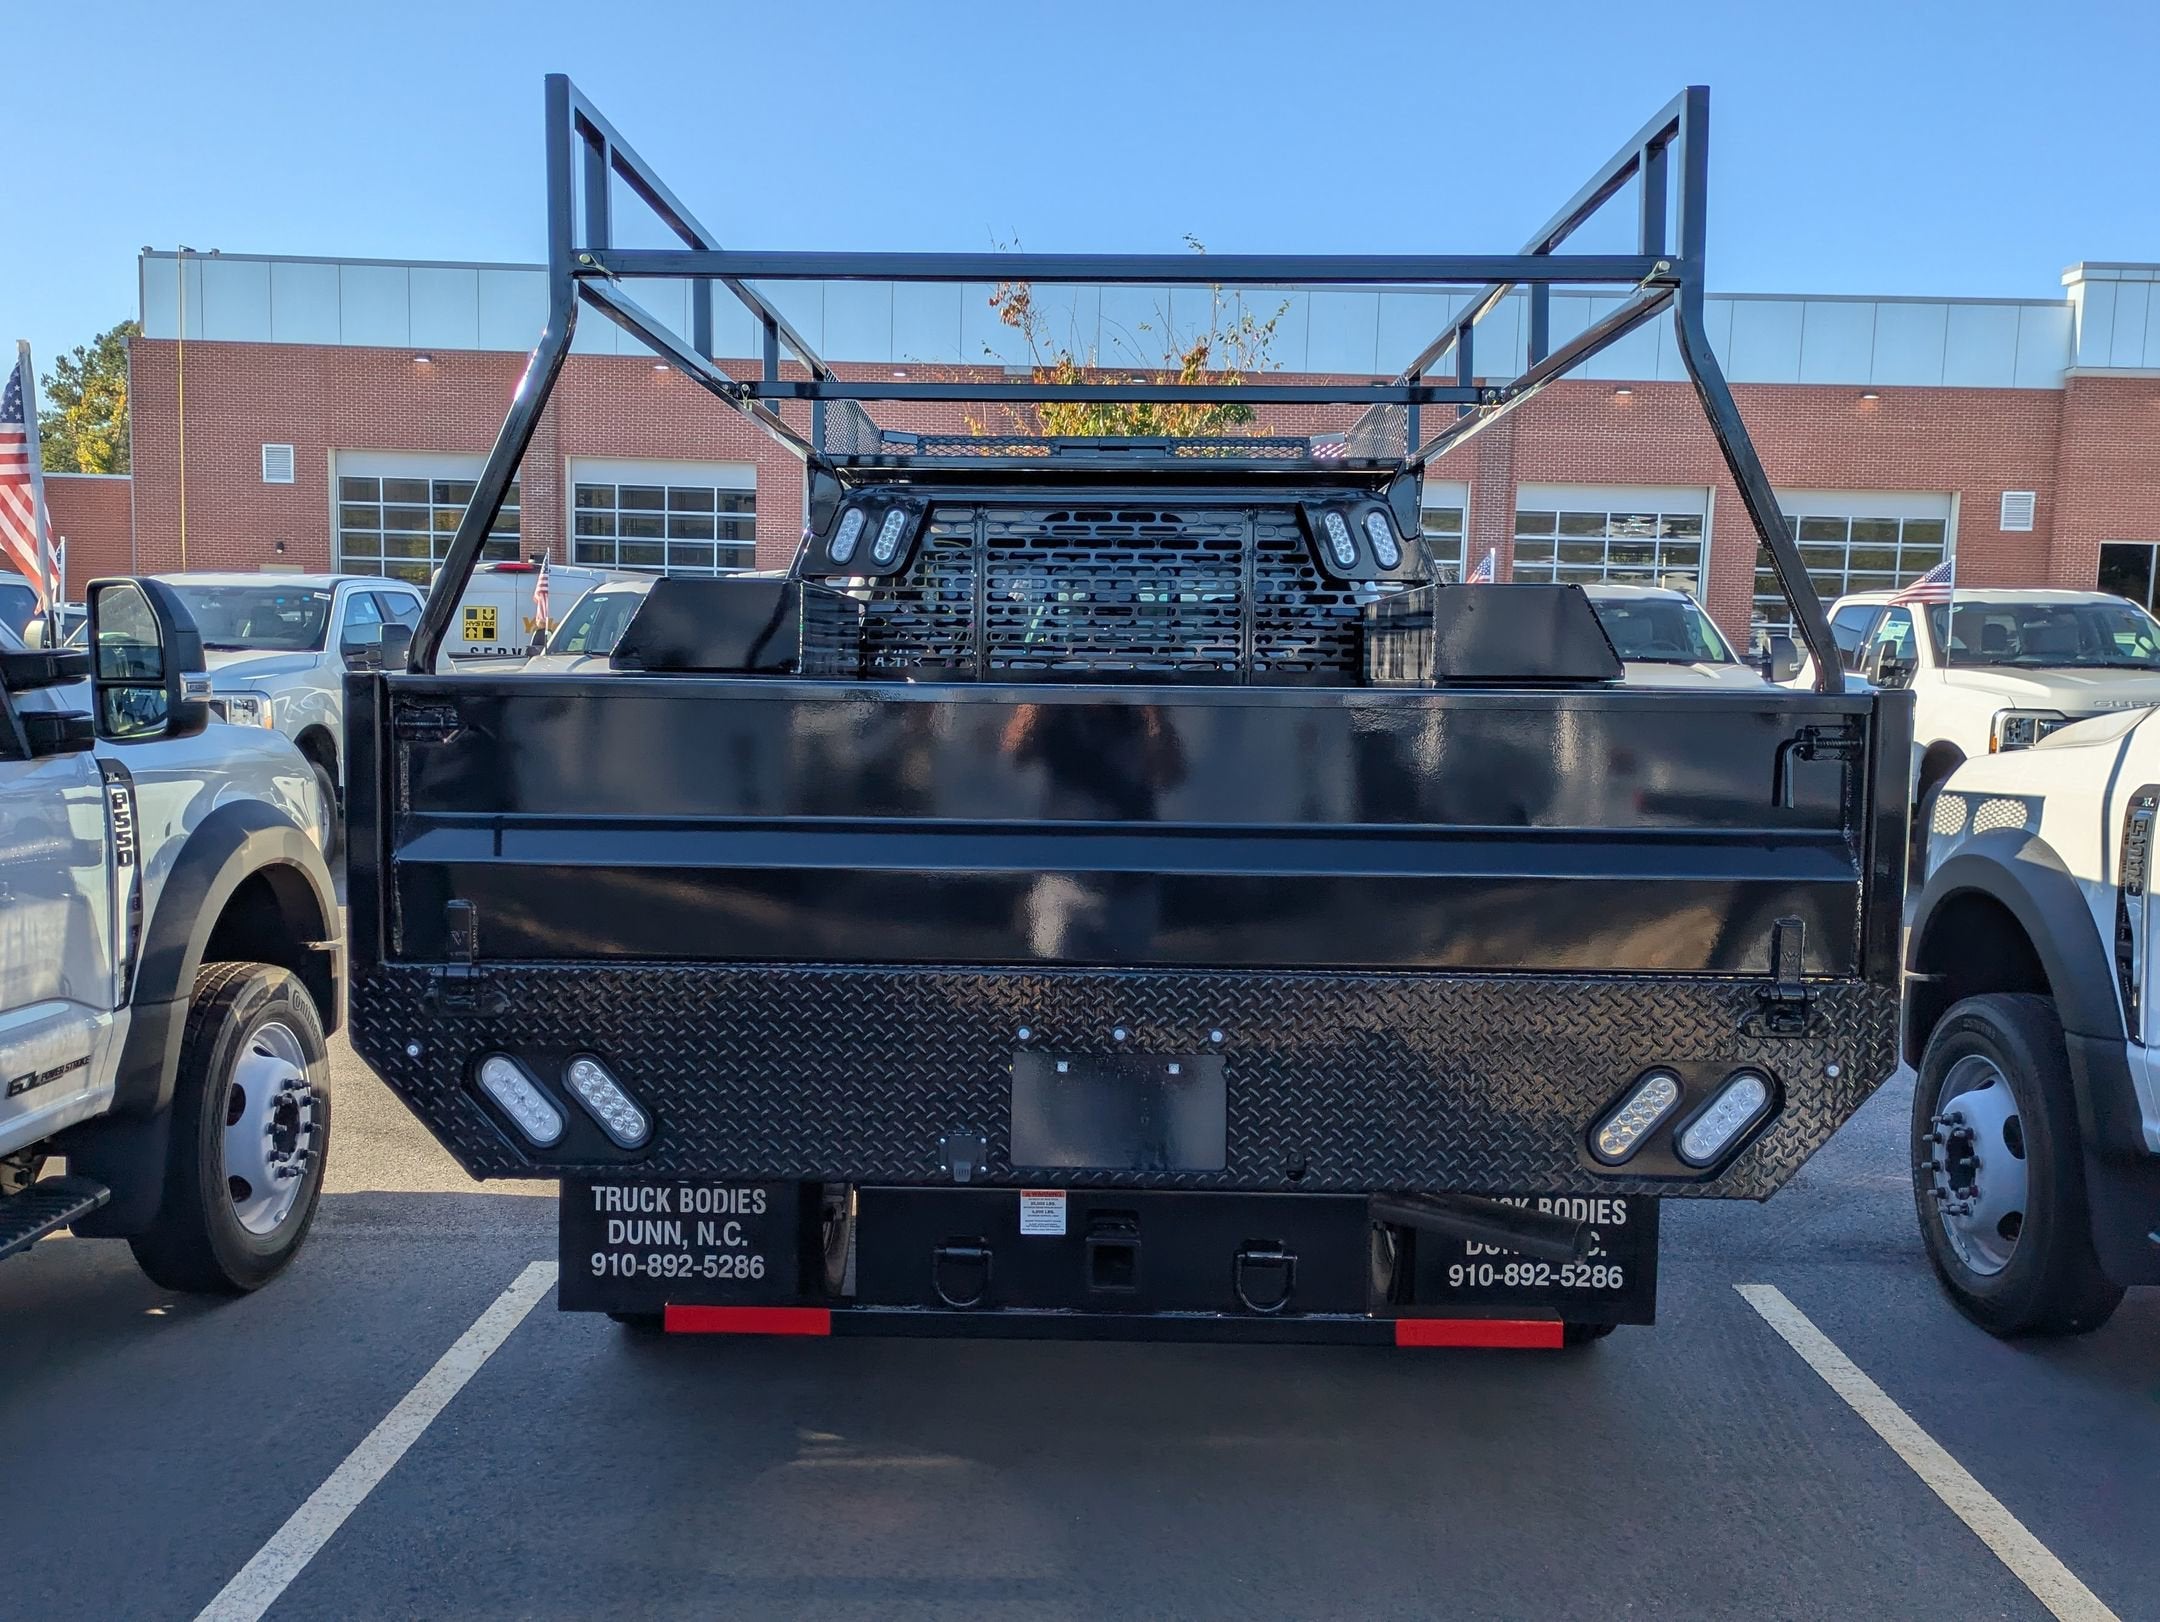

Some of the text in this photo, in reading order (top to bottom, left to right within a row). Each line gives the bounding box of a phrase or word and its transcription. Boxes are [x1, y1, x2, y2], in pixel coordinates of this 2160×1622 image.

[591, 1186, 767, 1214] TRUCK BODIES
[608, 1219, 748, 1250] DUNN, N.C.
[591, 1252, 765, 1279] 910-892-5286
[1449, 1263, 1623, 1289] 910-892-5286
